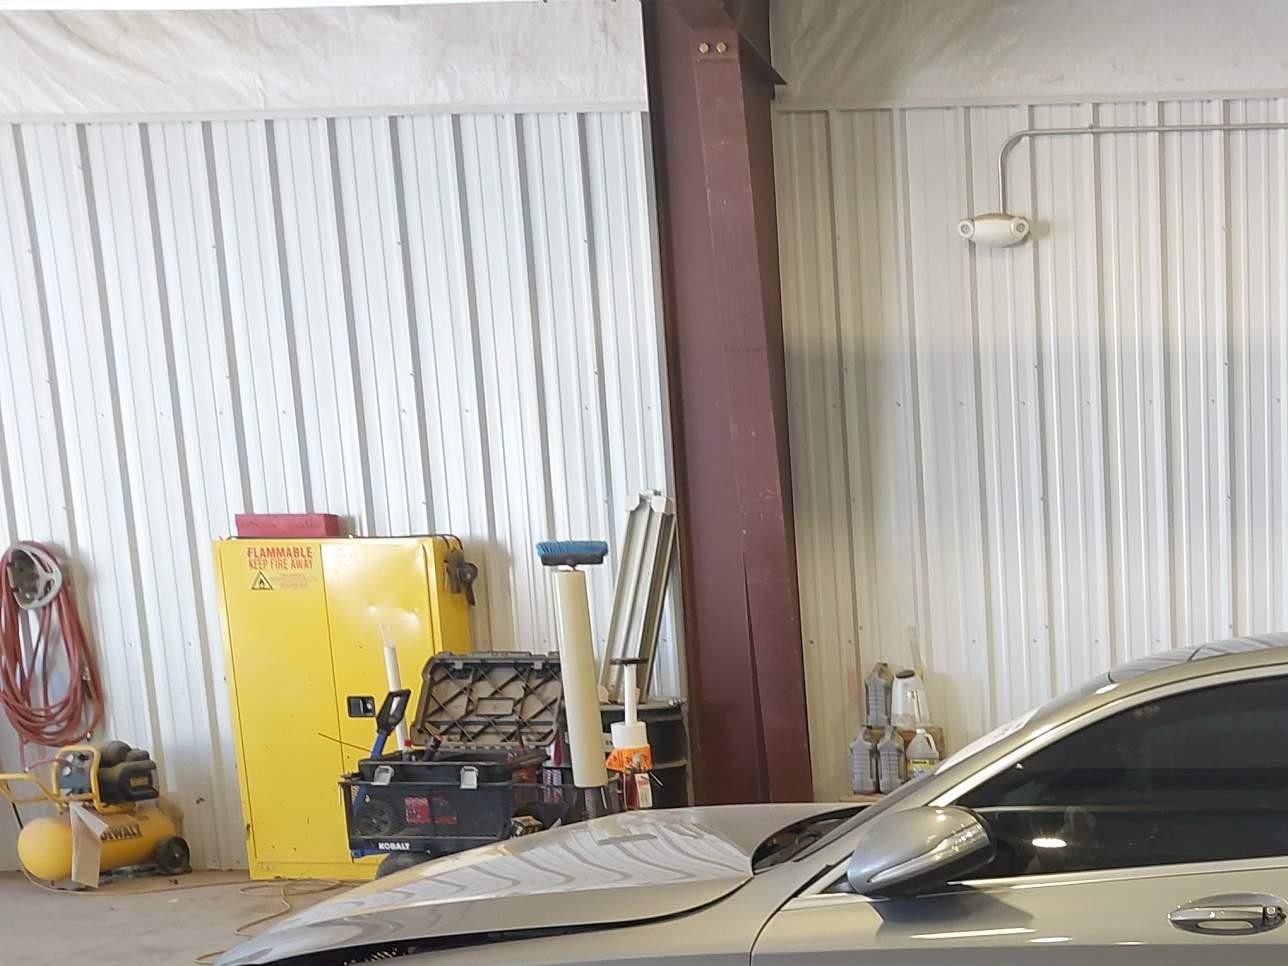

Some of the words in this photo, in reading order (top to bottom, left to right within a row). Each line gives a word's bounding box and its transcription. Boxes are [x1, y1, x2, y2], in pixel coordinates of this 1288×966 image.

[247, 546, 313, 558] FLAMMABLE
[249, 559, 268, 570] KEEP
[270, 559, 289, 570] FIRE
[291, 559, 313, 570] AWAY
[378, 842, 411, 851] KOBALT
